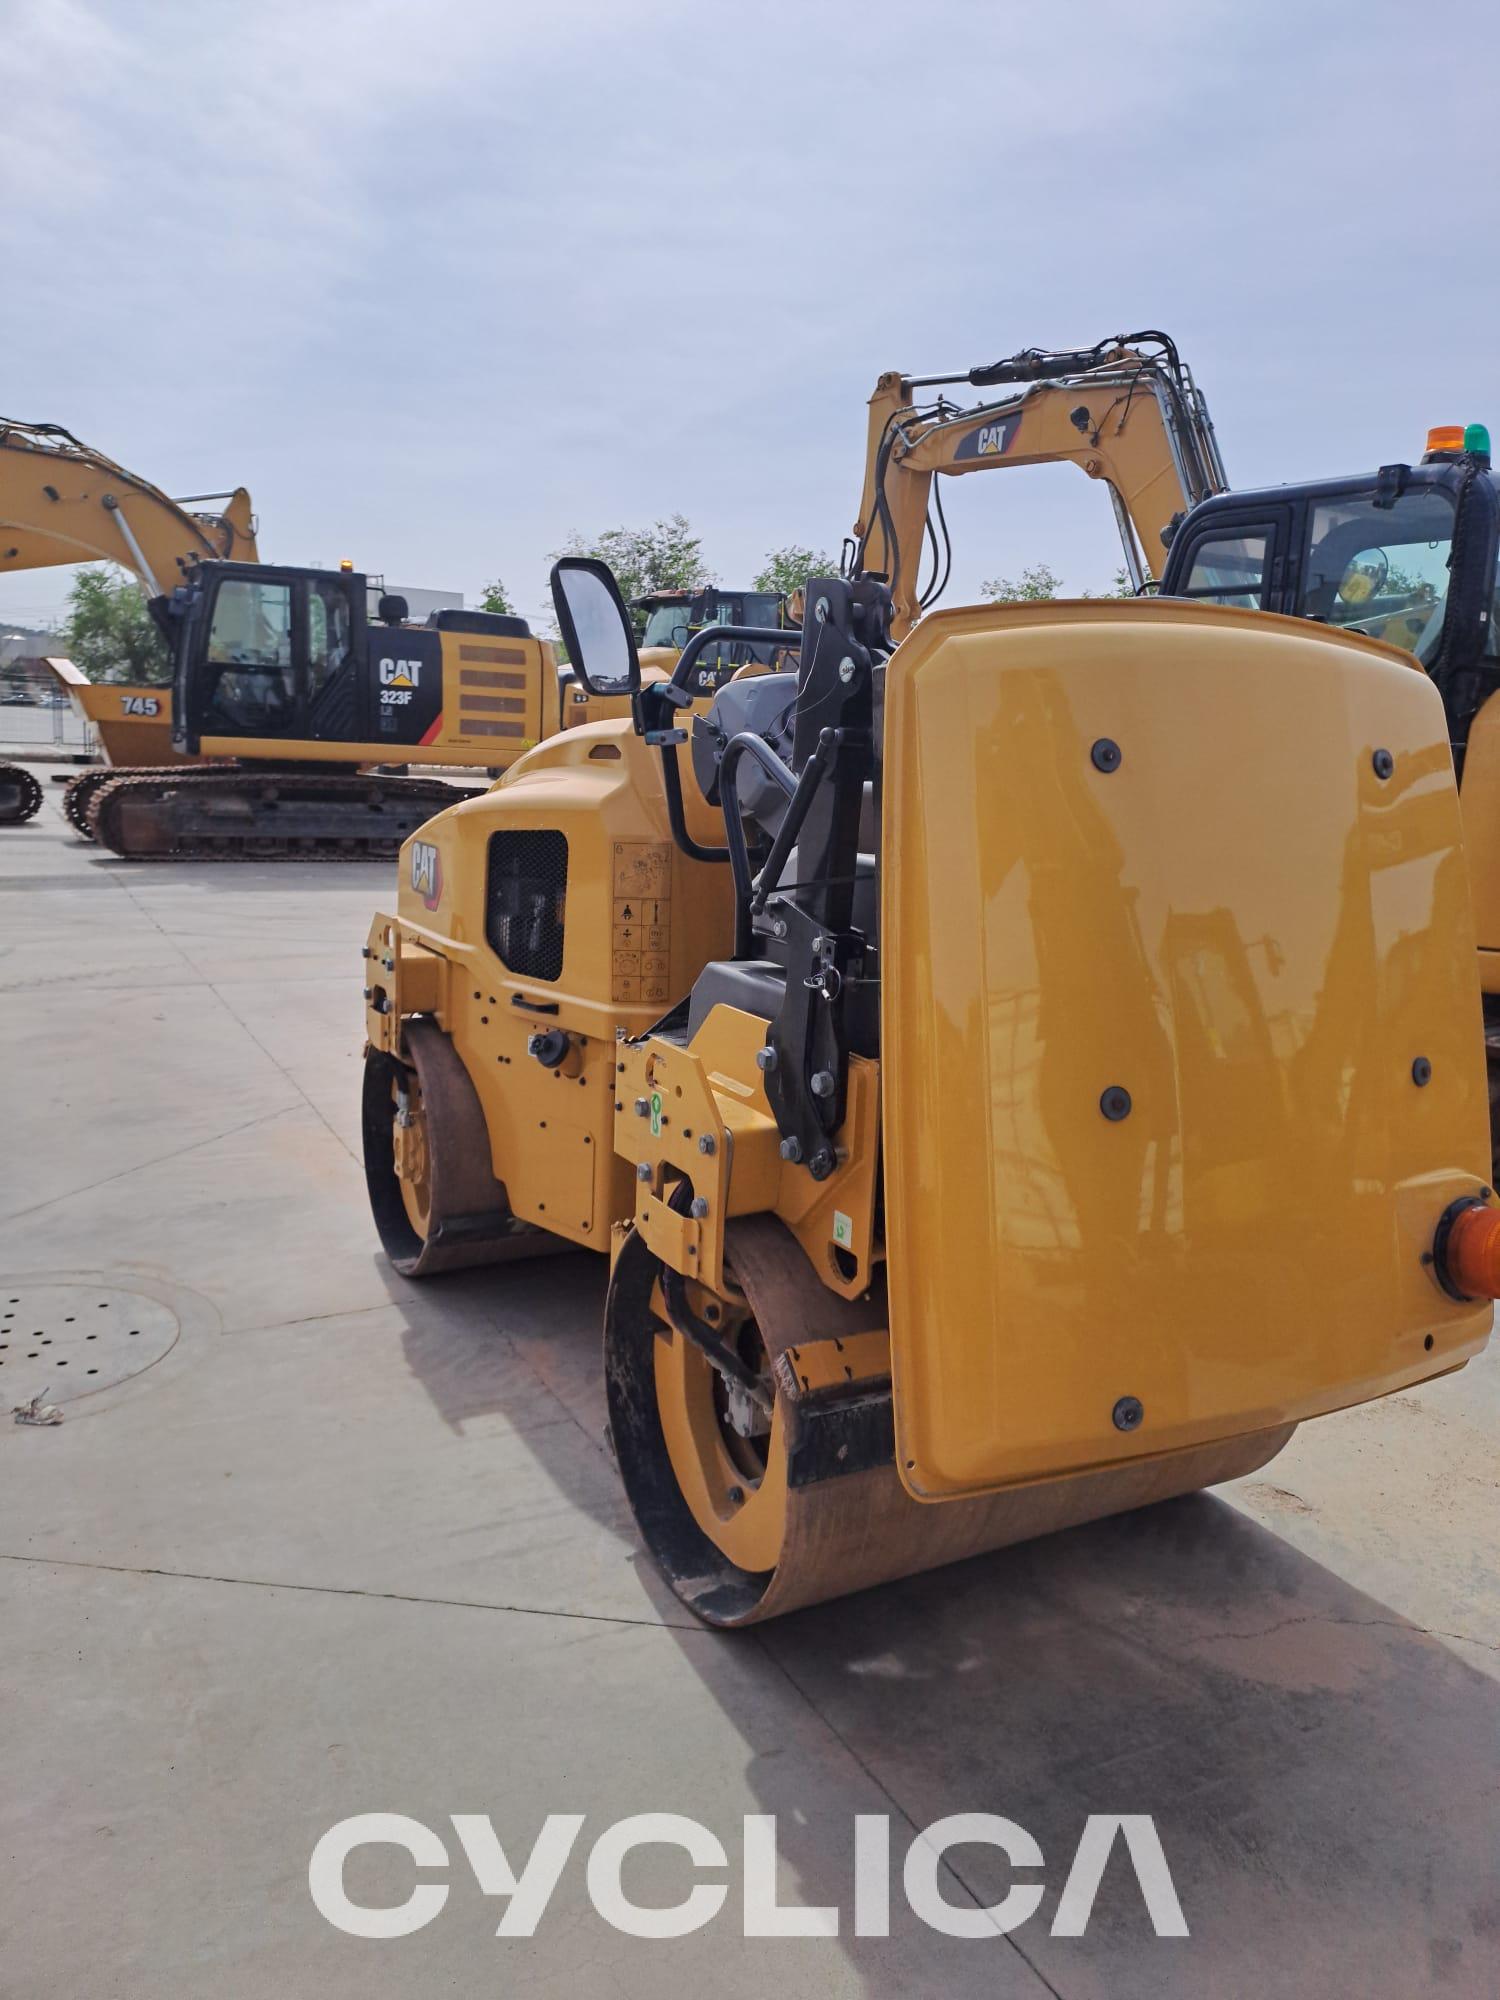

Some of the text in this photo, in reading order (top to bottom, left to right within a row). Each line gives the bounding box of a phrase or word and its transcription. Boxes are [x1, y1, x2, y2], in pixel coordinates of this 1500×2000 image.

[977, 425, 1007, 455] CAT
[379, 657, 423, 687] CAT
[120, 696, 158, 716] 745
[379, 689, 413, 705] 323F
[412, 841, 437, 896] CAT
